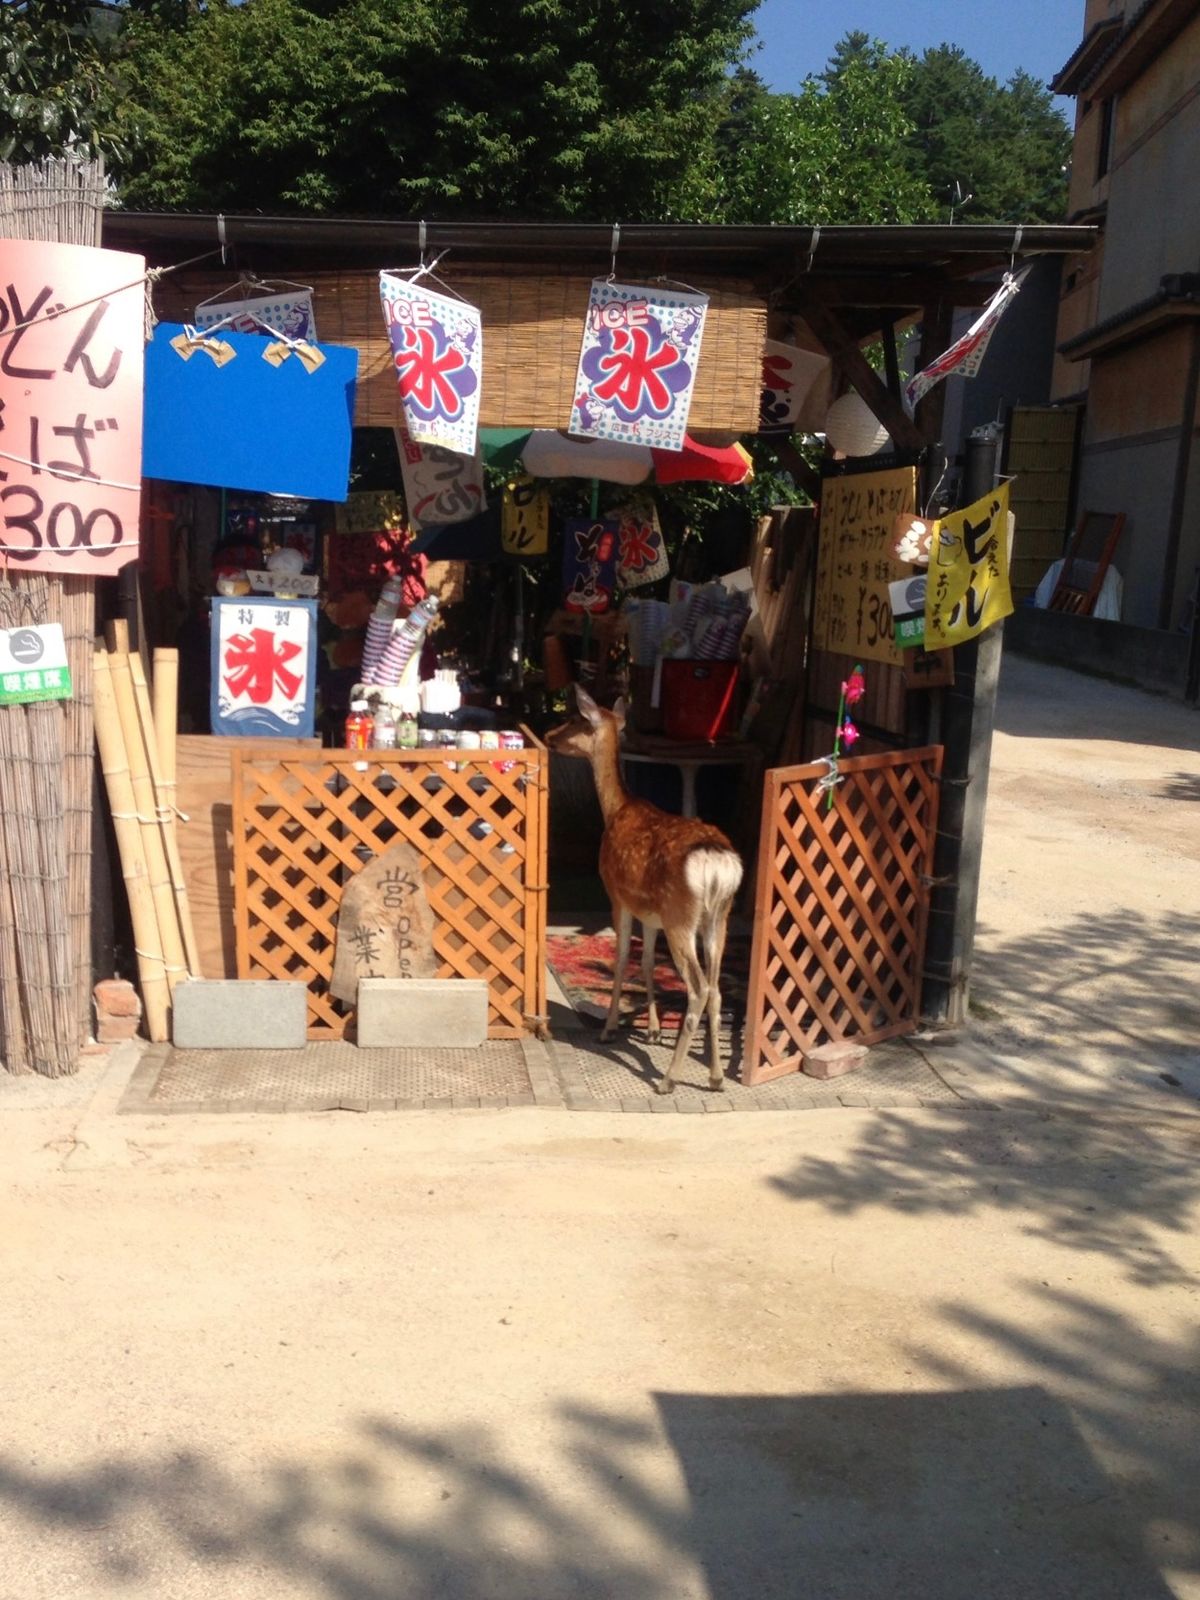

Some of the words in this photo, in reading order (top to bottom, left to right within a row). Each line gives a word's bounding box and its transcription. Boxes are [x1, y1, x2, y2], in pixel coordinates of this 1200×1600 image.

[0, 283, 123, 389] どん
[384, 298, 433, 326] ICE
[591, 299, 648, 332] ICE
[394, 324, 465, 415] 氷
[593, 328, 680, 412] 氷
[0, 397, 119, 482] ば
[0, 484, 123, 562] 300
[238, 608, 291, 626] 特製
[223, 627, 304, 704] 氷
